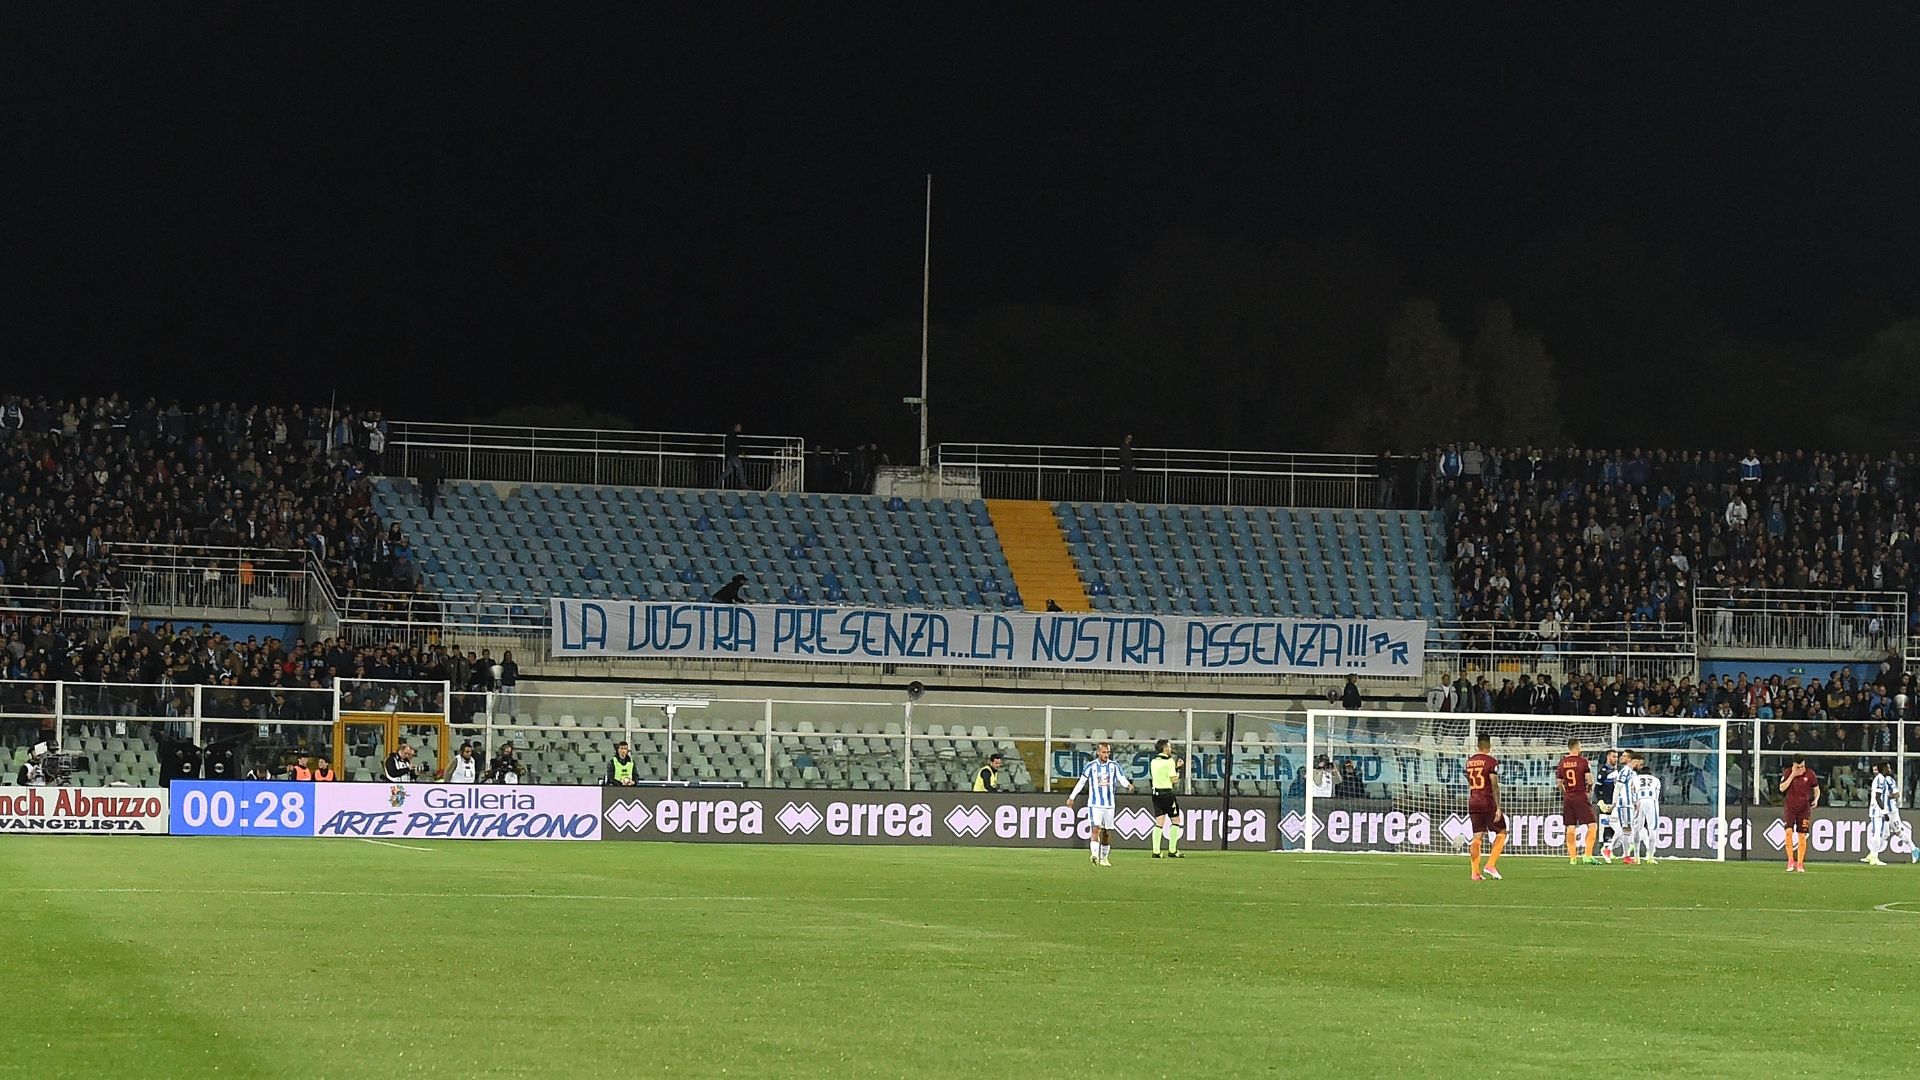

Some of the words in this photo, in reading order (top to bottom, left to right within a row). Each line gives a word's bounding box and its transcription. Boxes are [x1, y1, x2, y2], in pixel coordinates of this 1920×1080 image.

[560, 601, 607, 650] LA
[628, 605, 756, 653] VOSTRA
[1032, 616, 1166, 665] NOSTRA
[1186, 620, 1368, 669] ASSENZA!!!
[1466, 767, 1486, 790] 33
[1565, 768, 1578, 787] 9
[53, 788, 161, 818] Abruzzo
[183, 790, 305, 828] 00:28
[424, 788, 536, 810] Galleria
[319, 810, 403, 835] ARTE
[403, 811, 599, 838] PENTAGONO
